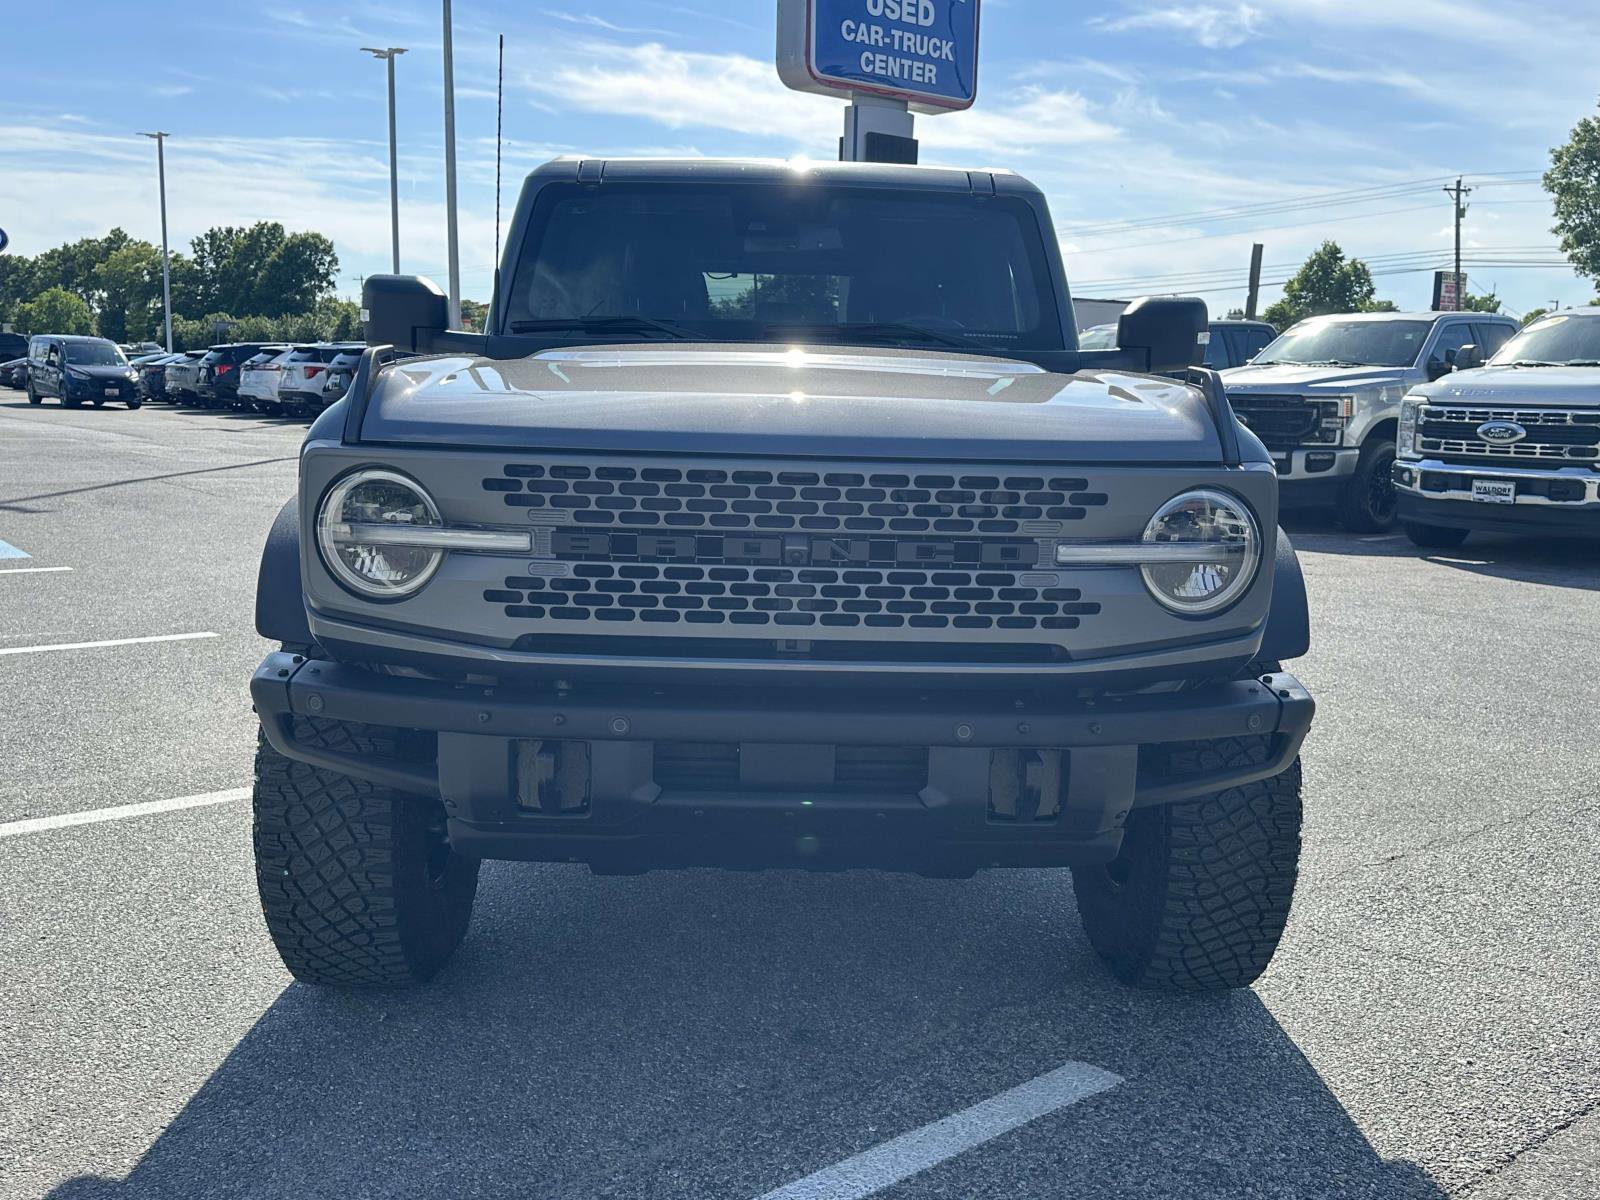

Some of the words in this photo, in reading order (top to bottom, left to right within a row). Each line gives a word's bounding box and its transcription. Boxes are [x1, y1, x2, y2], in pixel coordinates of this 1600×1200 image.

[866, 0, 935, 27] USED
[841, 19, 954, 62] CAR-TRUCK
[860, 51, 937, 84] CENTER
[1475, 485, 1512, 494] WALDORF
[551, 531, 1039, 565] BRONCO
